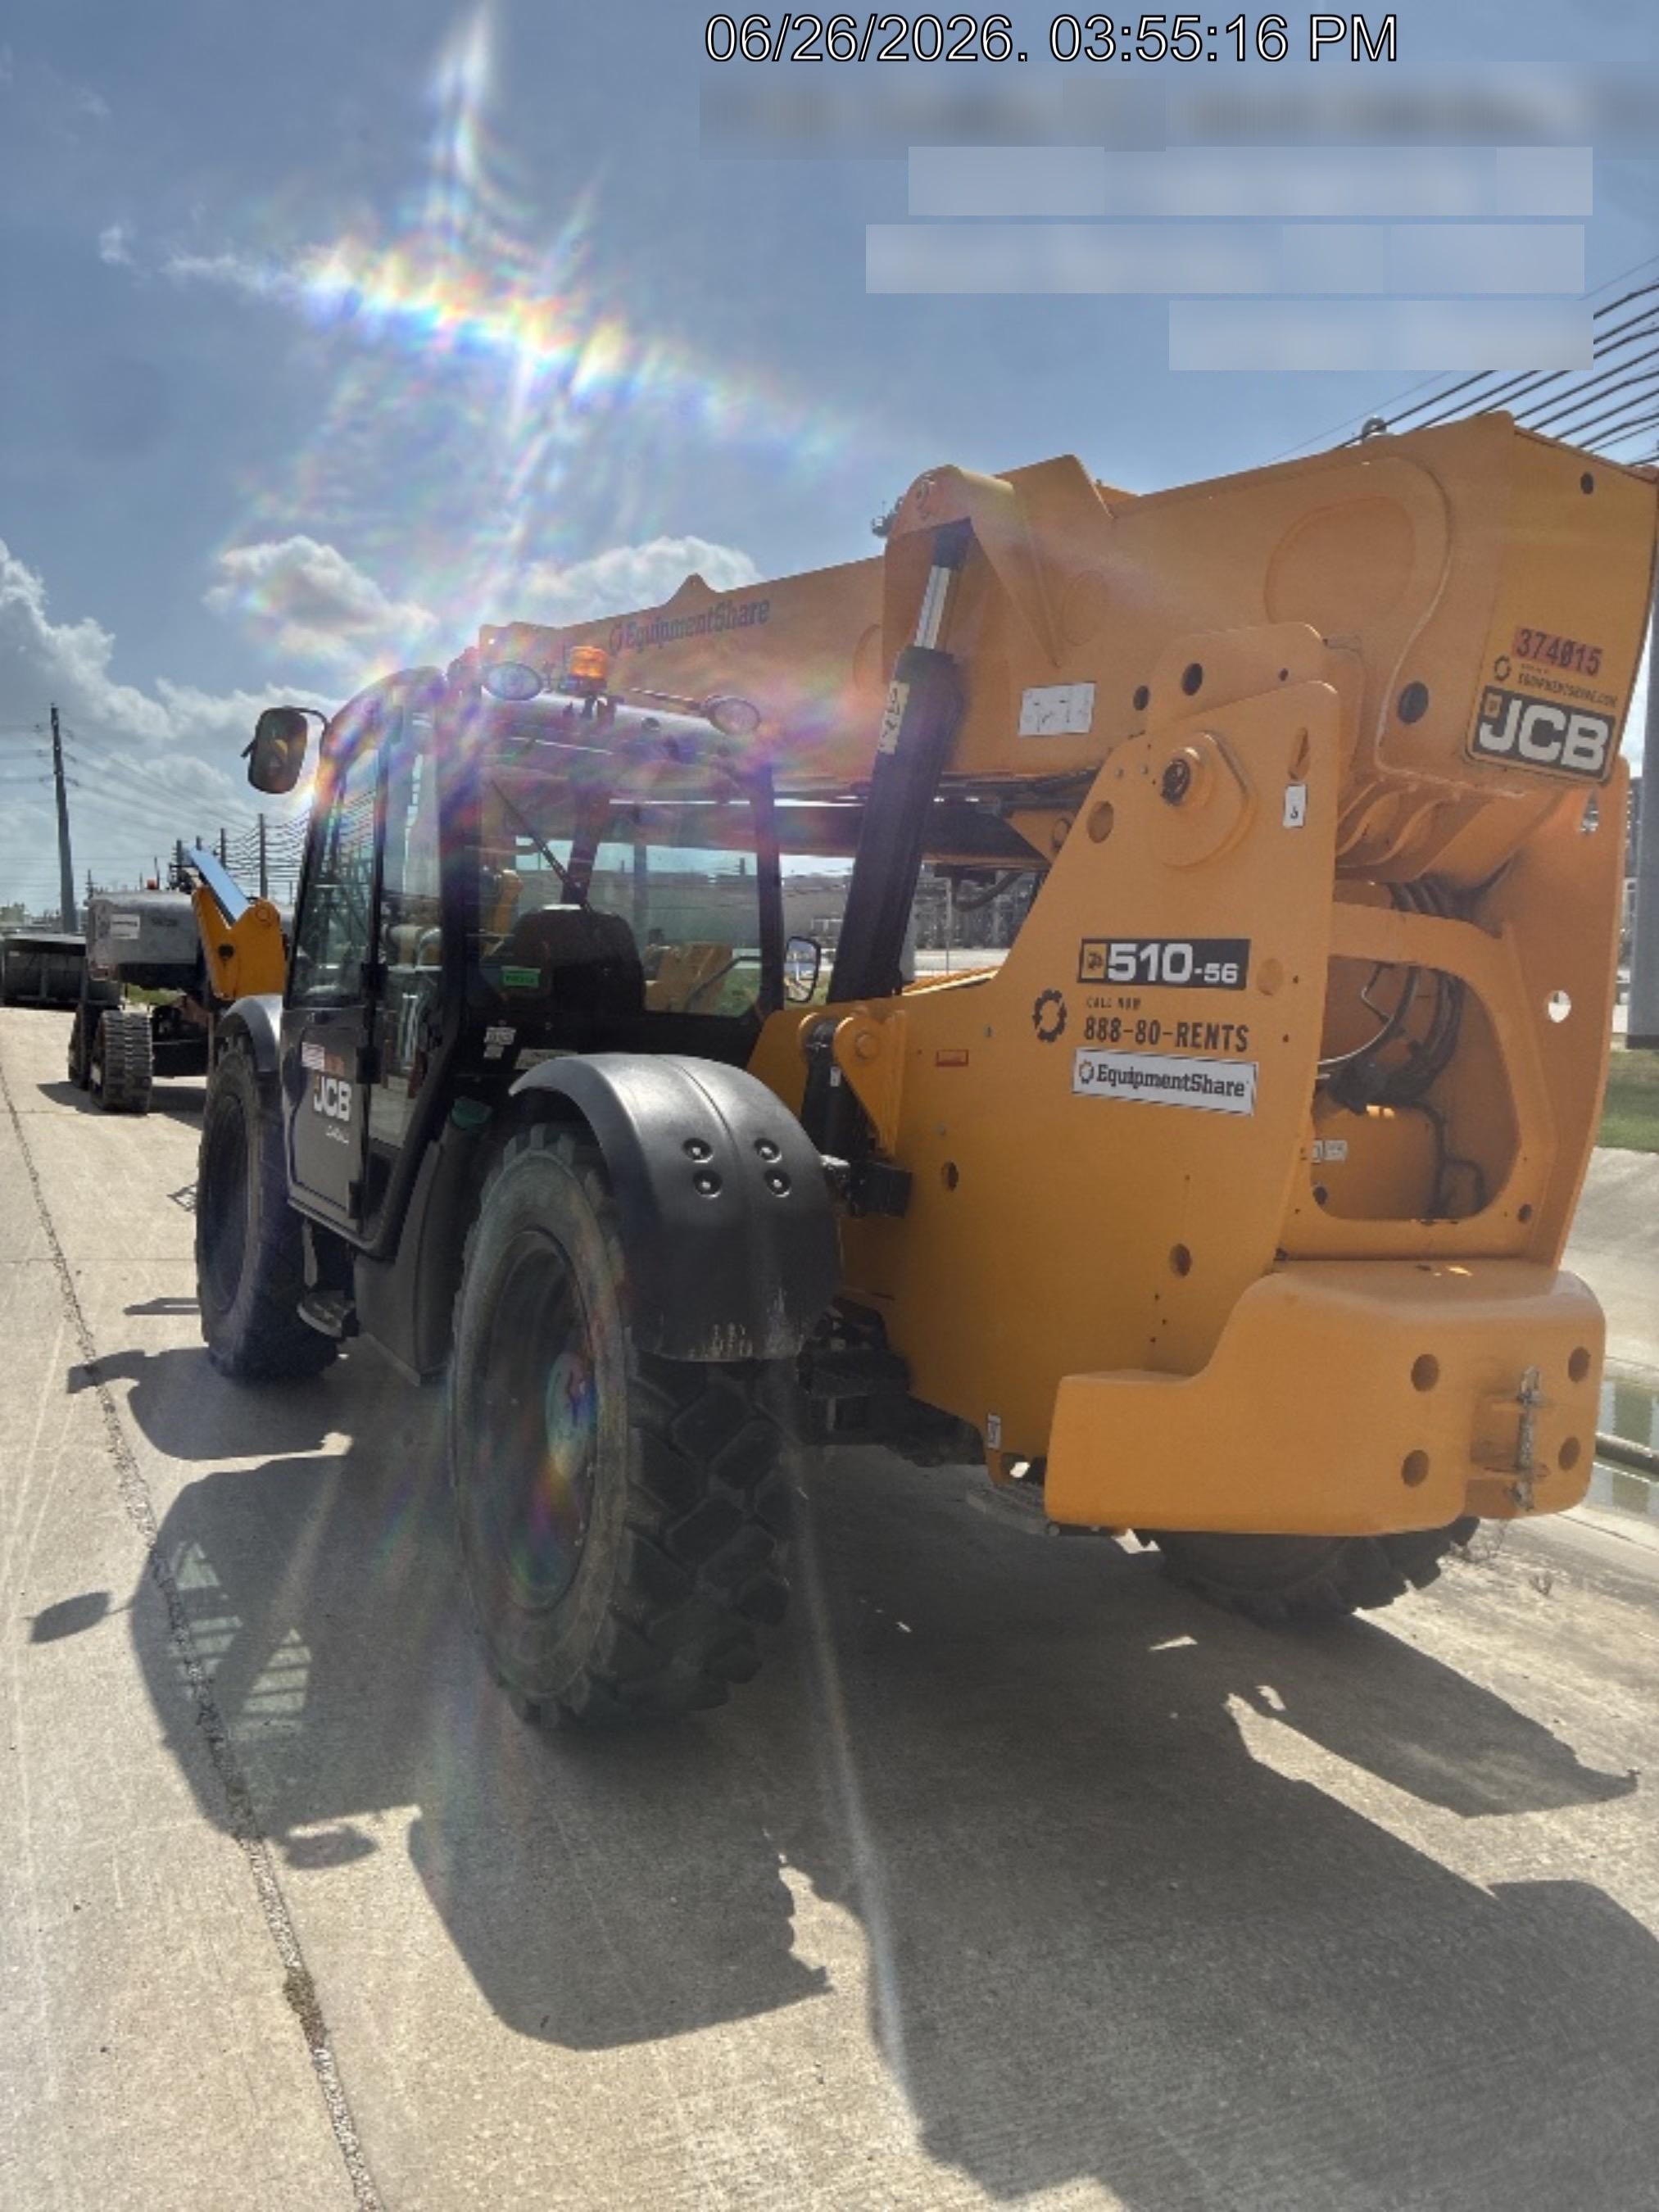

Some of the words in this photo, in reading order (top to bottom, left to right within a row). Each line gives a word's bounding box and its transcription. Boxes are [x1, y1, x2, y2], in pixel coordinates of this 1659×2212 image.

[627, 599, 770, 651] EquipmentShare
[1516, 628, 1603, 676] 374015
[1479, 698, 1608, 770] JCB
[1085, 1016, 1249, 1053] 888-80-RENTS
[314, 1076, 351, 1122] JCB
[1096, 1063, 1245, 1098] EquipmentShare
